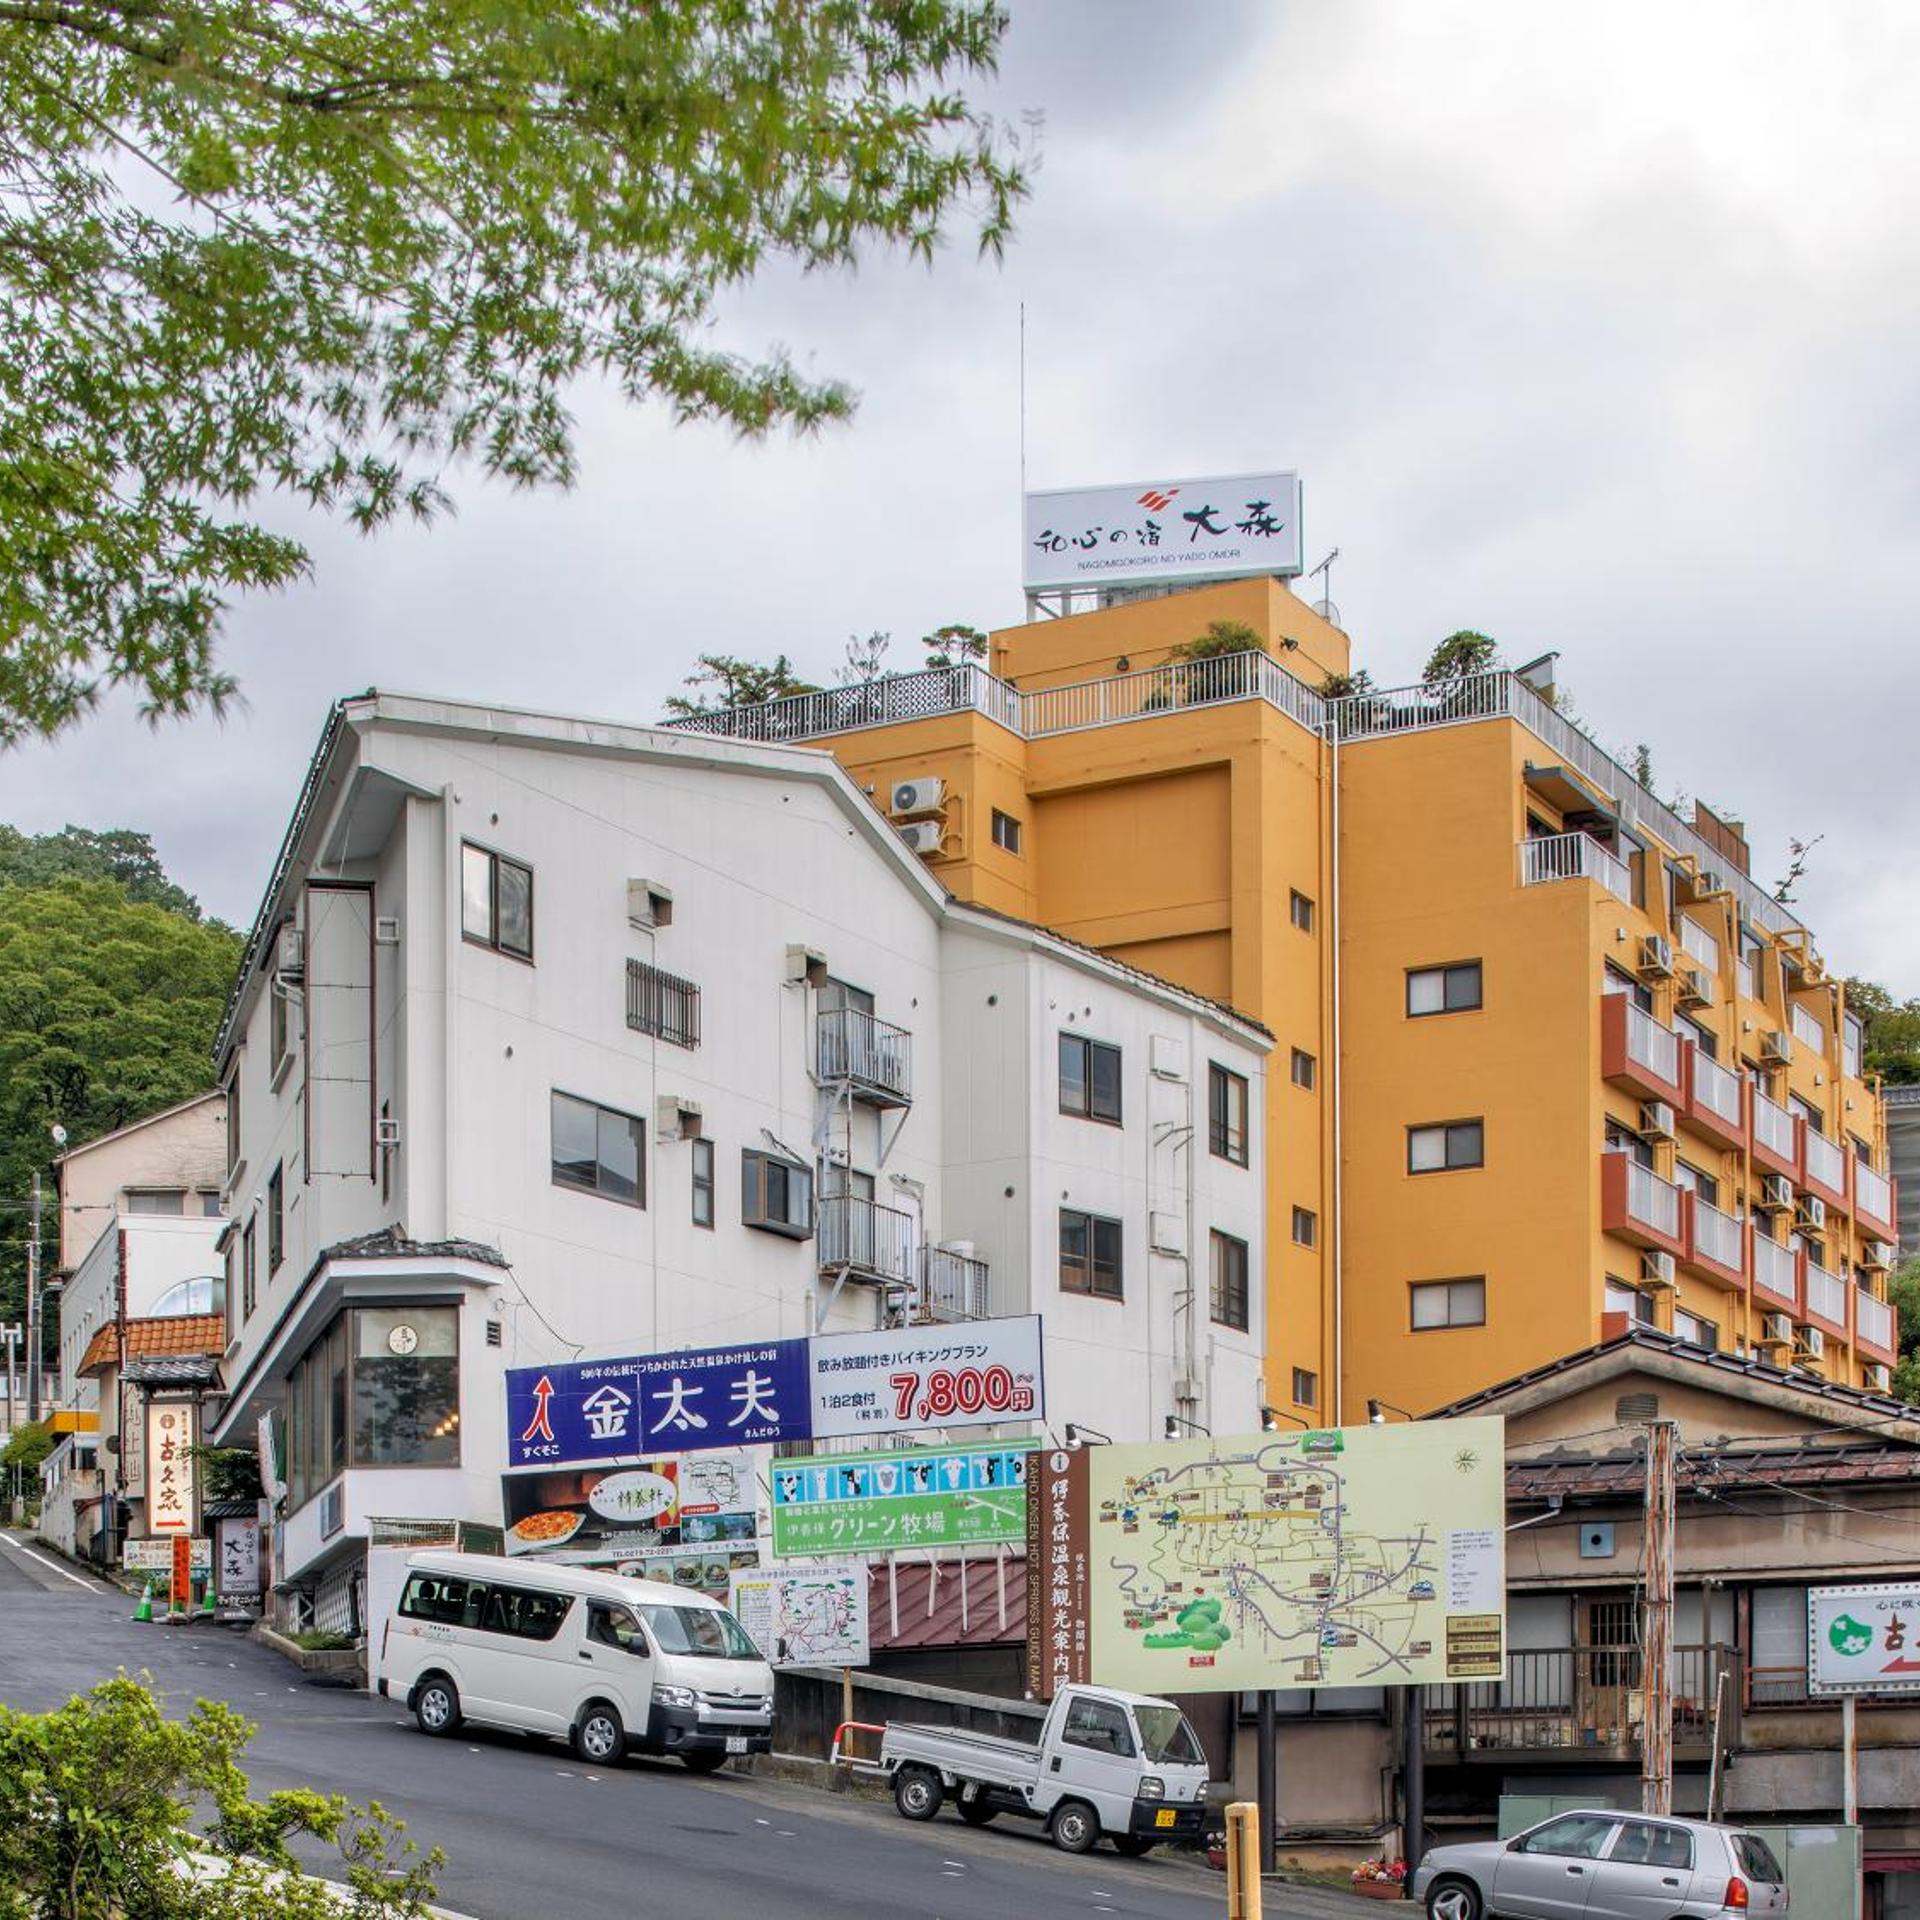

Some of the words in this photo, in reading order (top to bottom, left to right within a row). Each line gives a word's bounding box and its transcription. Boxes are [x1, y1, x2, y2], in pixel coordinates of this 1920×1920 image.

[1033, 519, 1162, 553] 和心の宿
[1183, 500, 1285, 542] 大森
[1160, 554, 1176, 564] NO
[1178, 551, 1206, 563] YADO
[1208, 549, 1241, 560] OMORI
[817, 1345, 988, 1373] 飲み放題付きバイキングプラン
[582, 1370, 781, 1440] 金太夫
[820, 1392, 876, 1409] 1泊2食付
[890, 1364, 1034, 1421] 7,800円
[522, 1444, 561, 1458] すぐそこ
[1028, 1455, 1040, 1494] IKAHO
[830, 1511, 945, 1539] グリーン牧場
[1028, 1499, 1040, 1540] ONSEN
[224, 1539, 244, 1577] 大森
[1028, 1543, 1040, 1570] HOT
[1029, 1625, 1041, 1662] GUIDE
[1029, 1664, 1041, 1692] MAP
